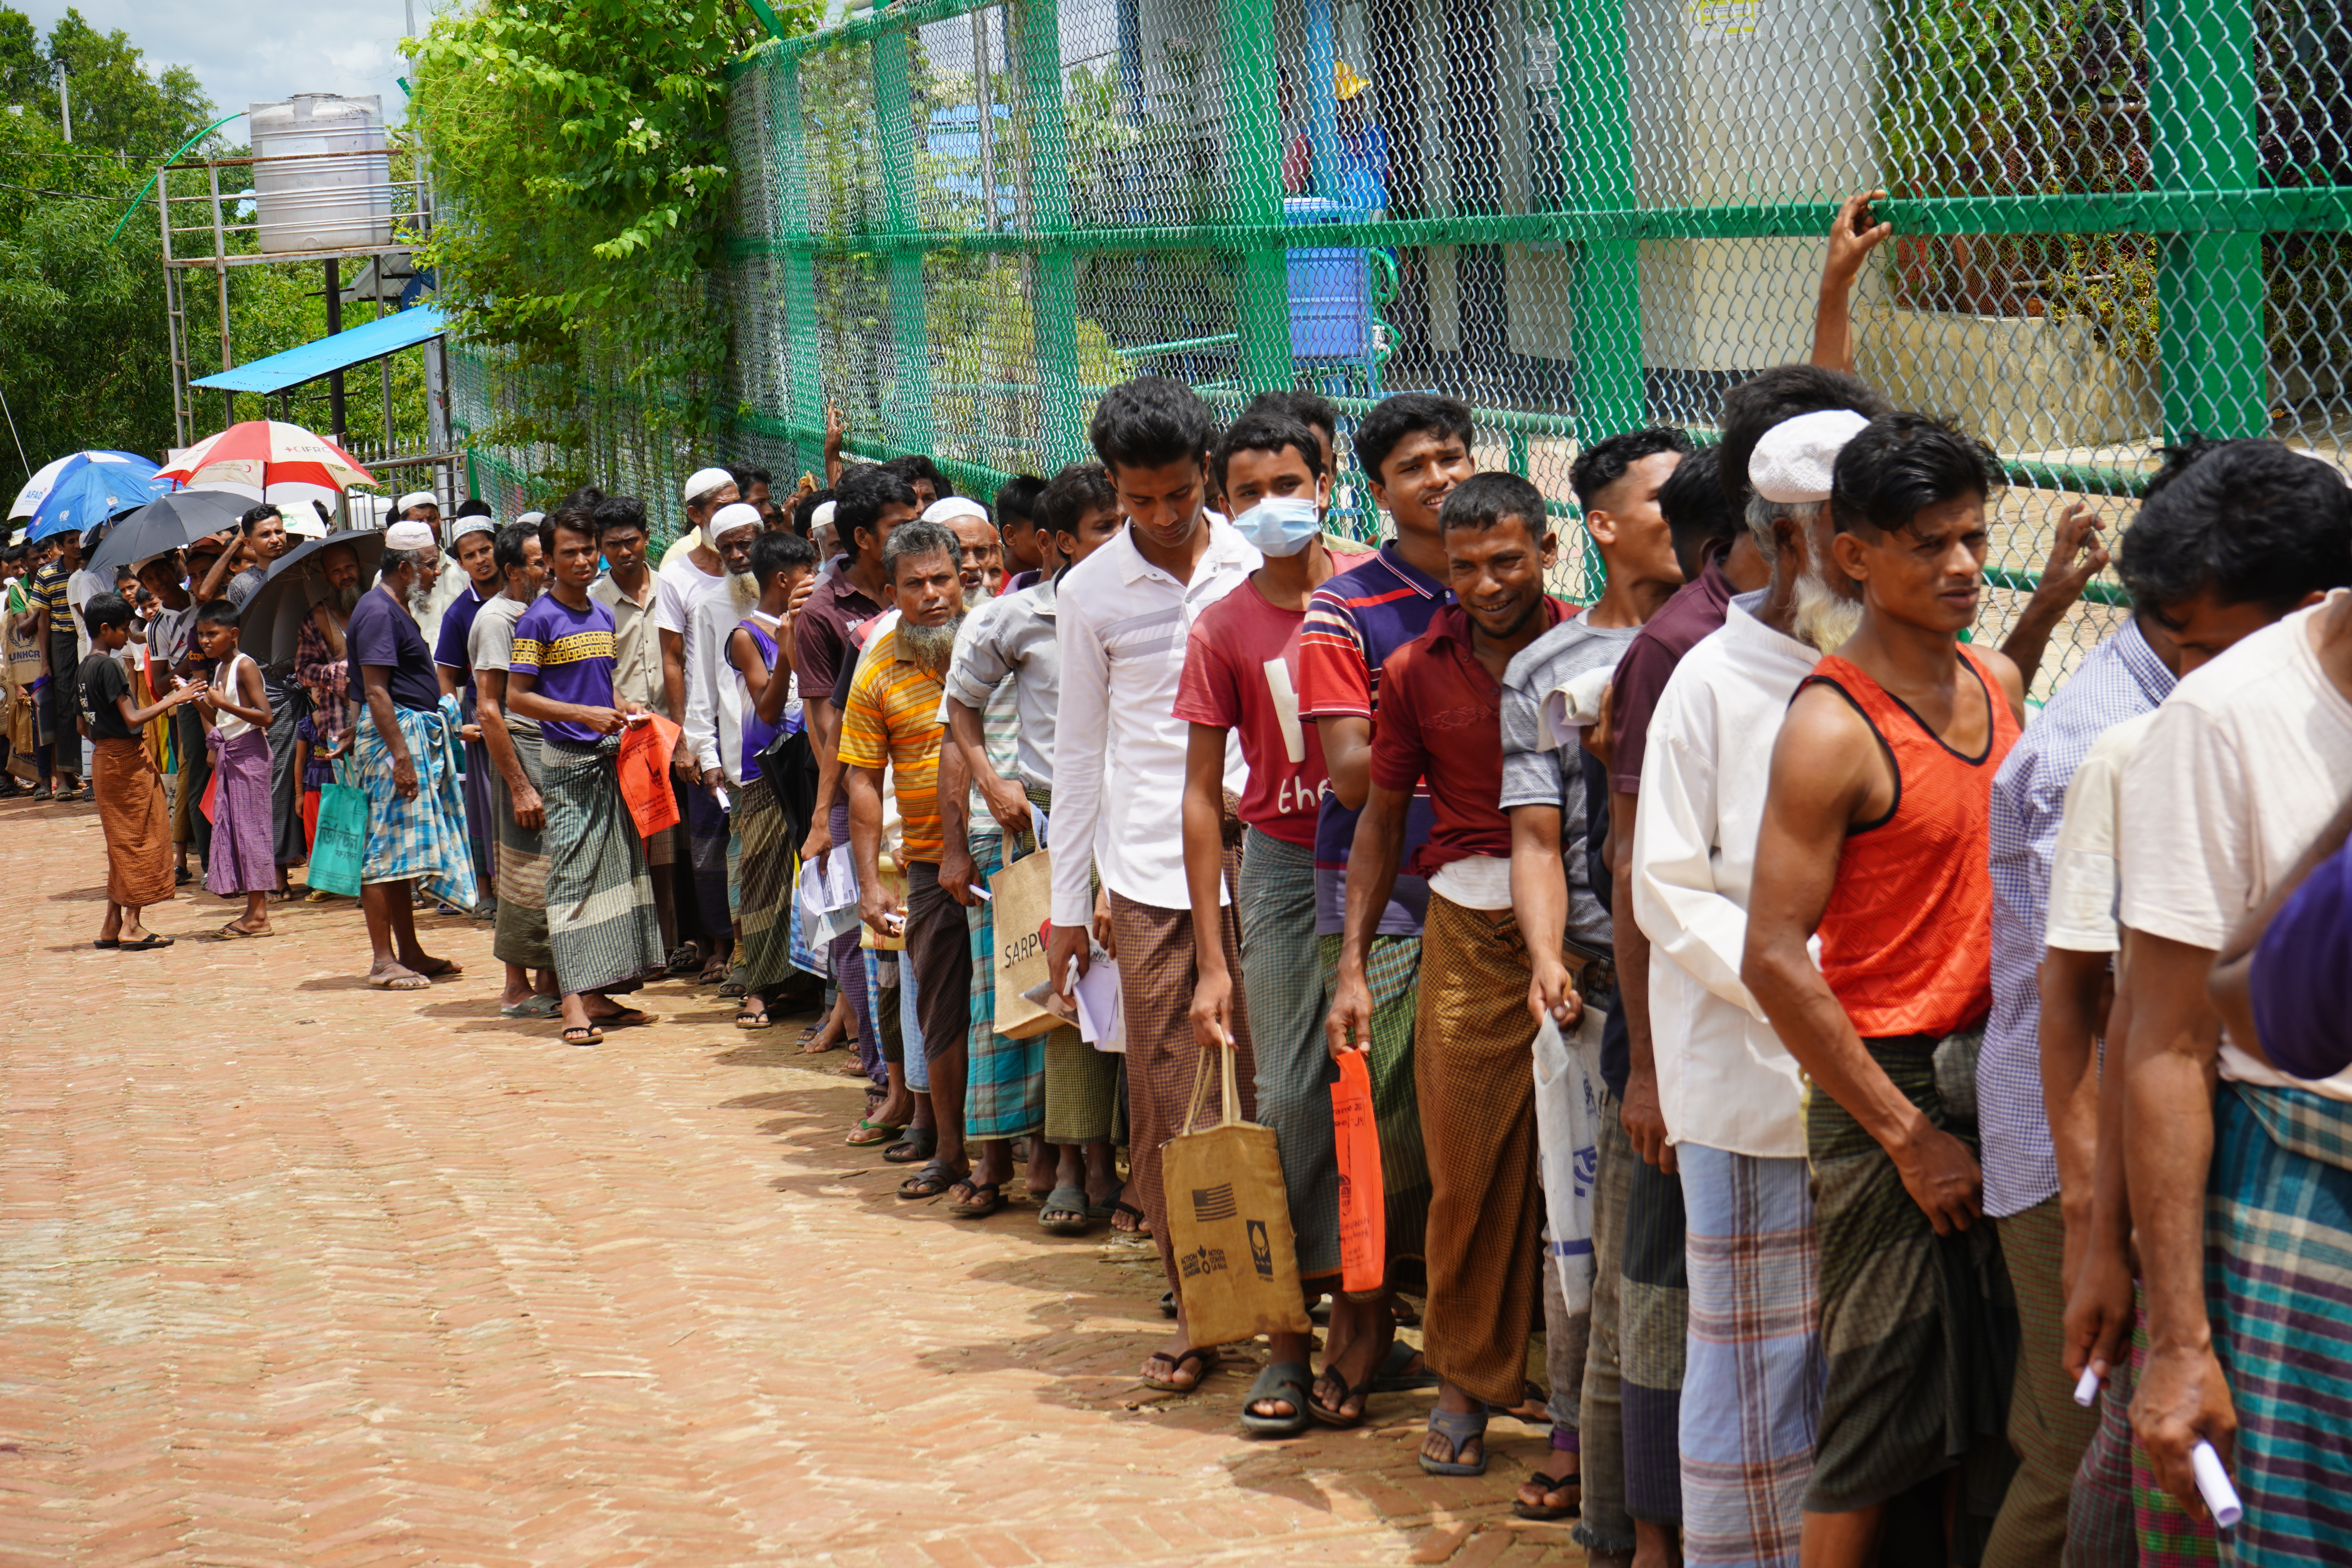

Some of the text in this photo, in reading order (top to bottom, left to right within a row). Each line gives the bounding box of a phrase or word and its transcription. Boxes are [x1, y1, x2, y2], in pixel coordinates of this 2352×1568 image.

[25, 490, 43, 499] AFAD
[9, 650, 40, 661] UNHCR
[13, 747, 37, 762] UNHC
[1005, 928, 1049, 968] SARPV
